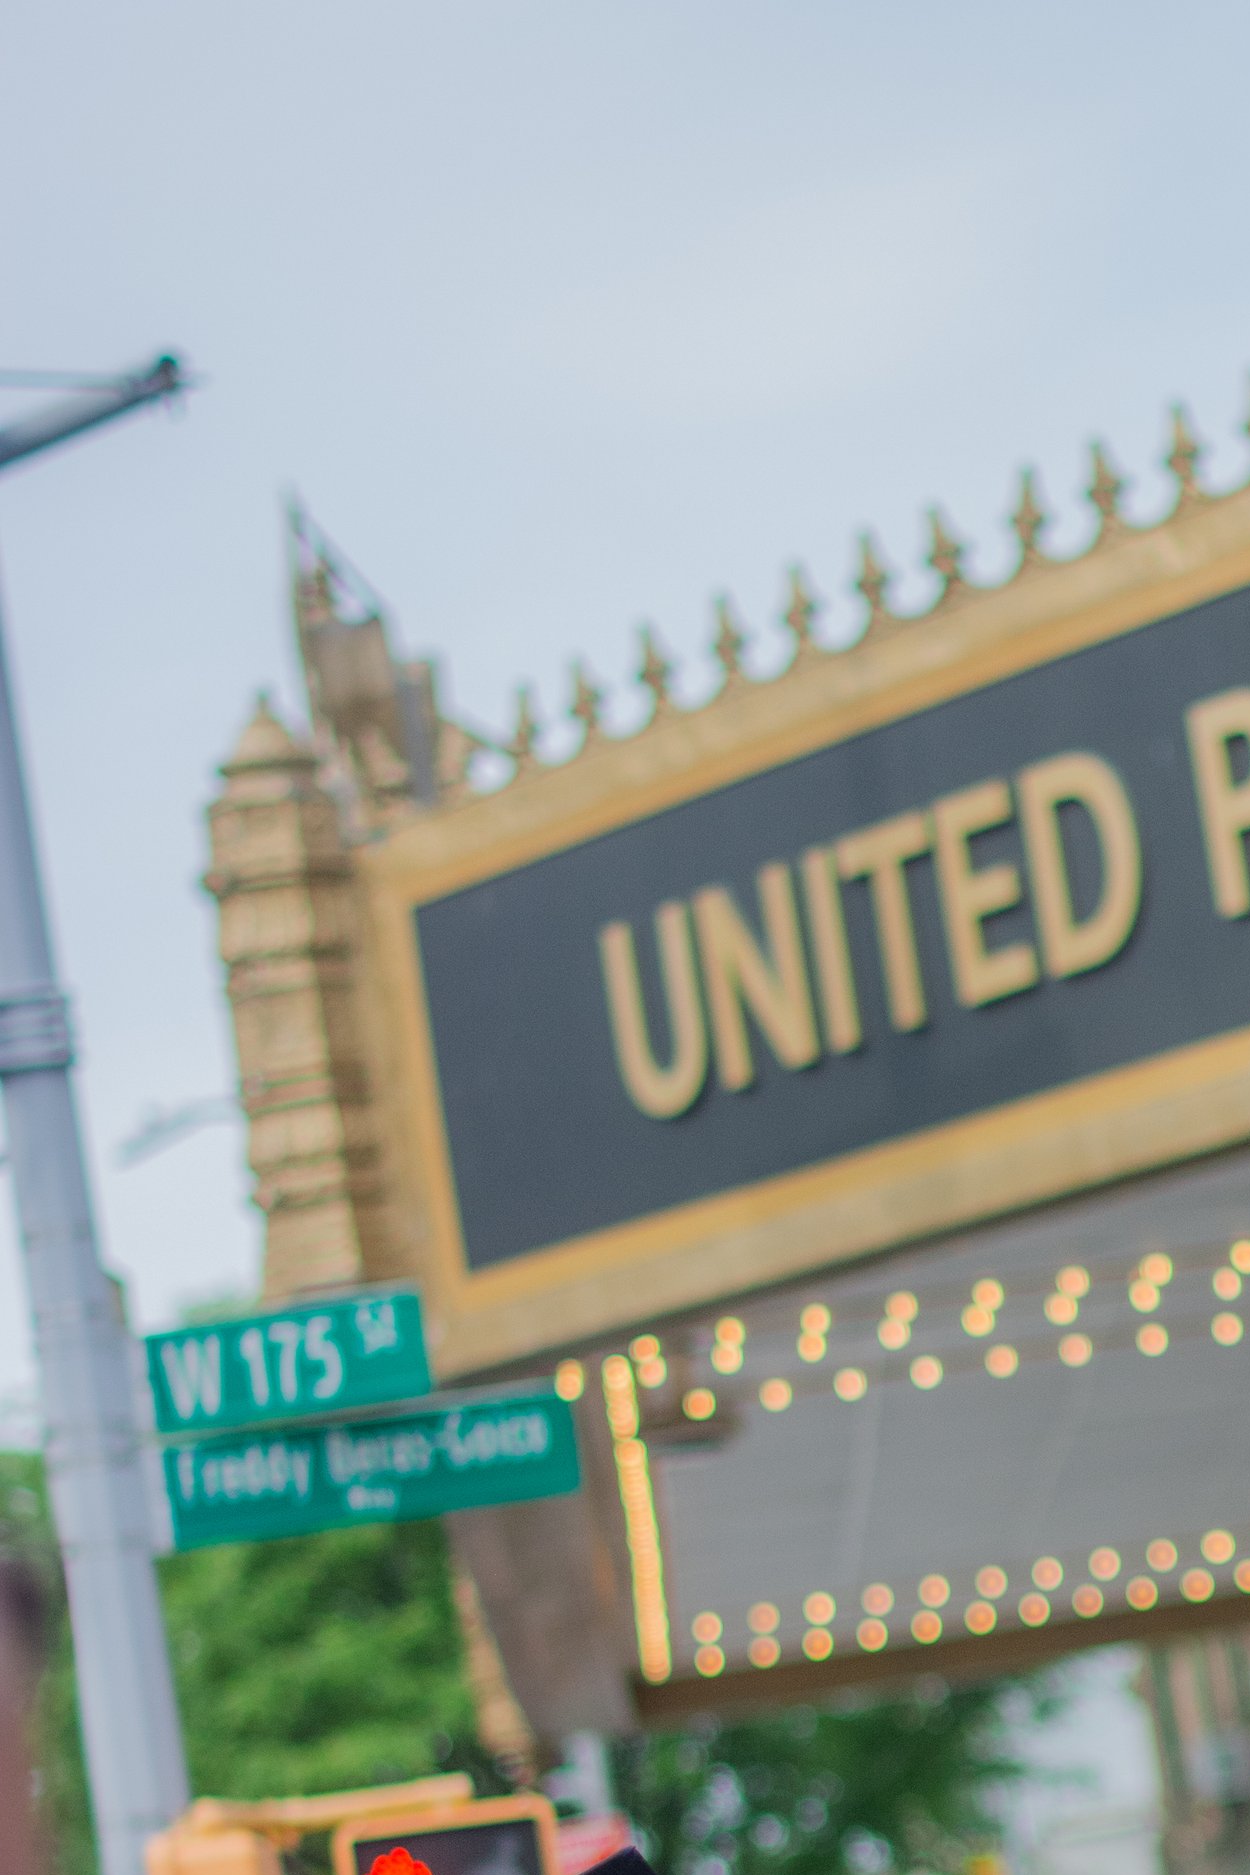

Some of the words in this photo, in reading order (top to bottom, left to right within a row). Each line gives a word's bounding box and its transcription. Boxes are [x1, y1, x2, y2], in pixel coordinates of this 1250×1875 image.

[600, 751, 1145, 1121] UNITED
[161, 1333, 221, 1420] W
[240, 1315, 343, 1408] 175
